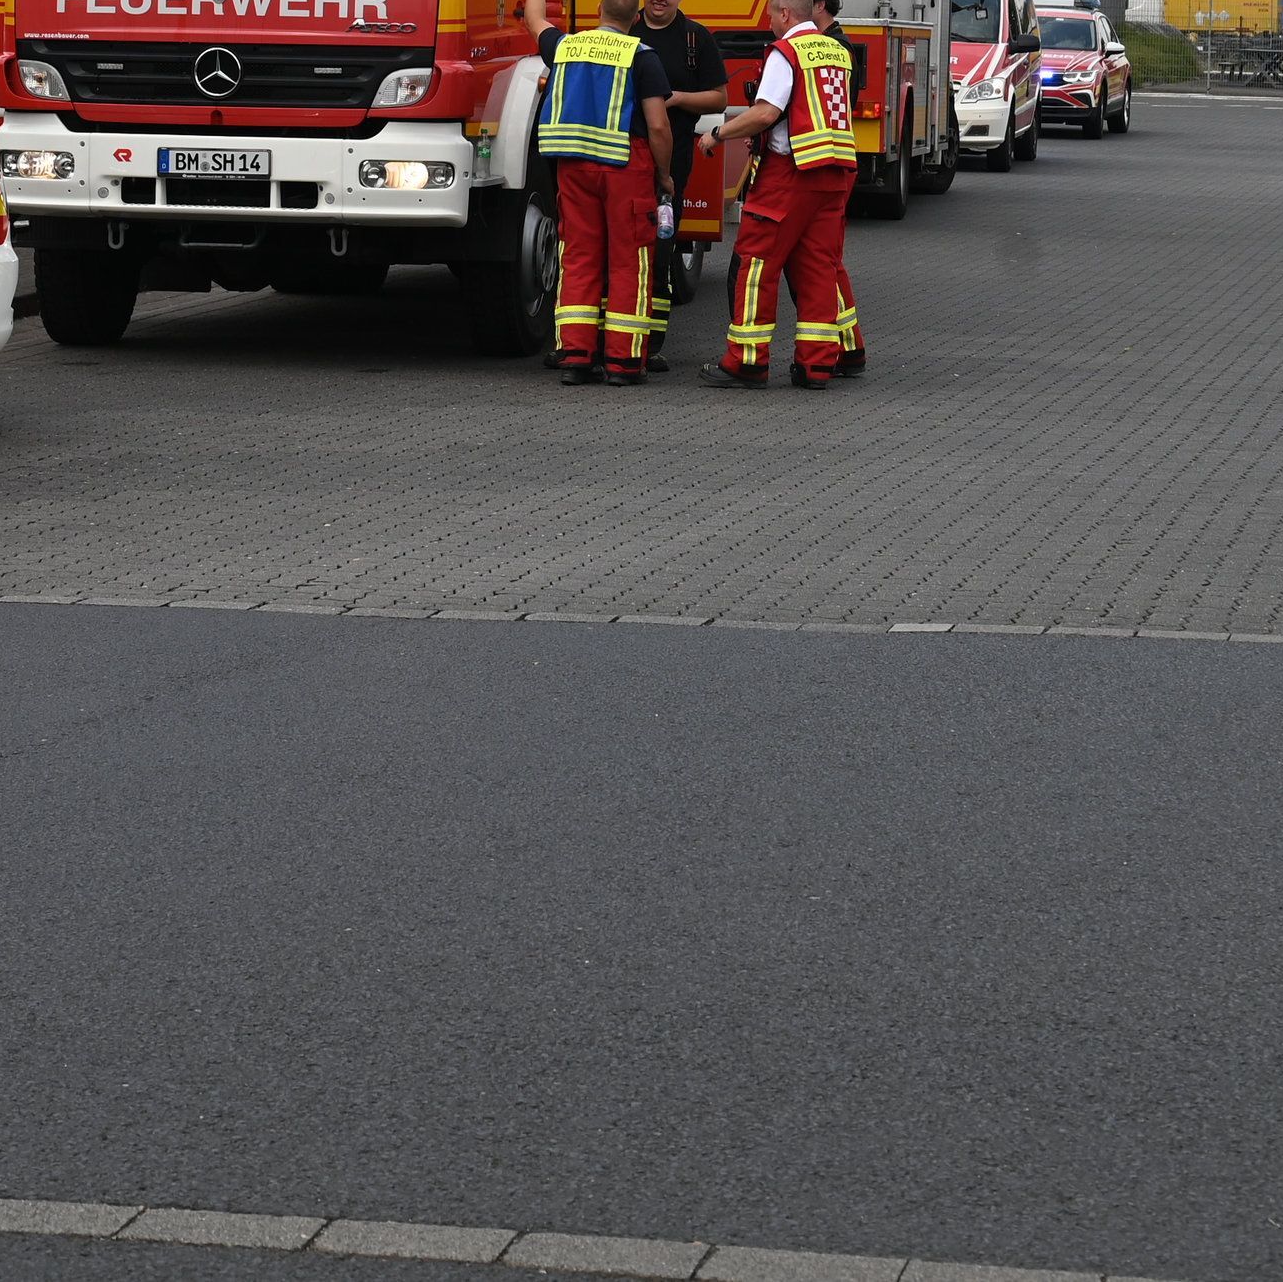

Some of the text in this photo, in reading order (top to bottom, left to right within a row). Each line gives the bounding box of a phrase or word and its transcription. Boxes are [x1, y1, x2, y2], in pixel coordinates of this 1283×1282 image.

[565, 46, 583, 58] TOJ
[588, 46, 622, 62] Einheit
[175, 152, 199, 171] BM
